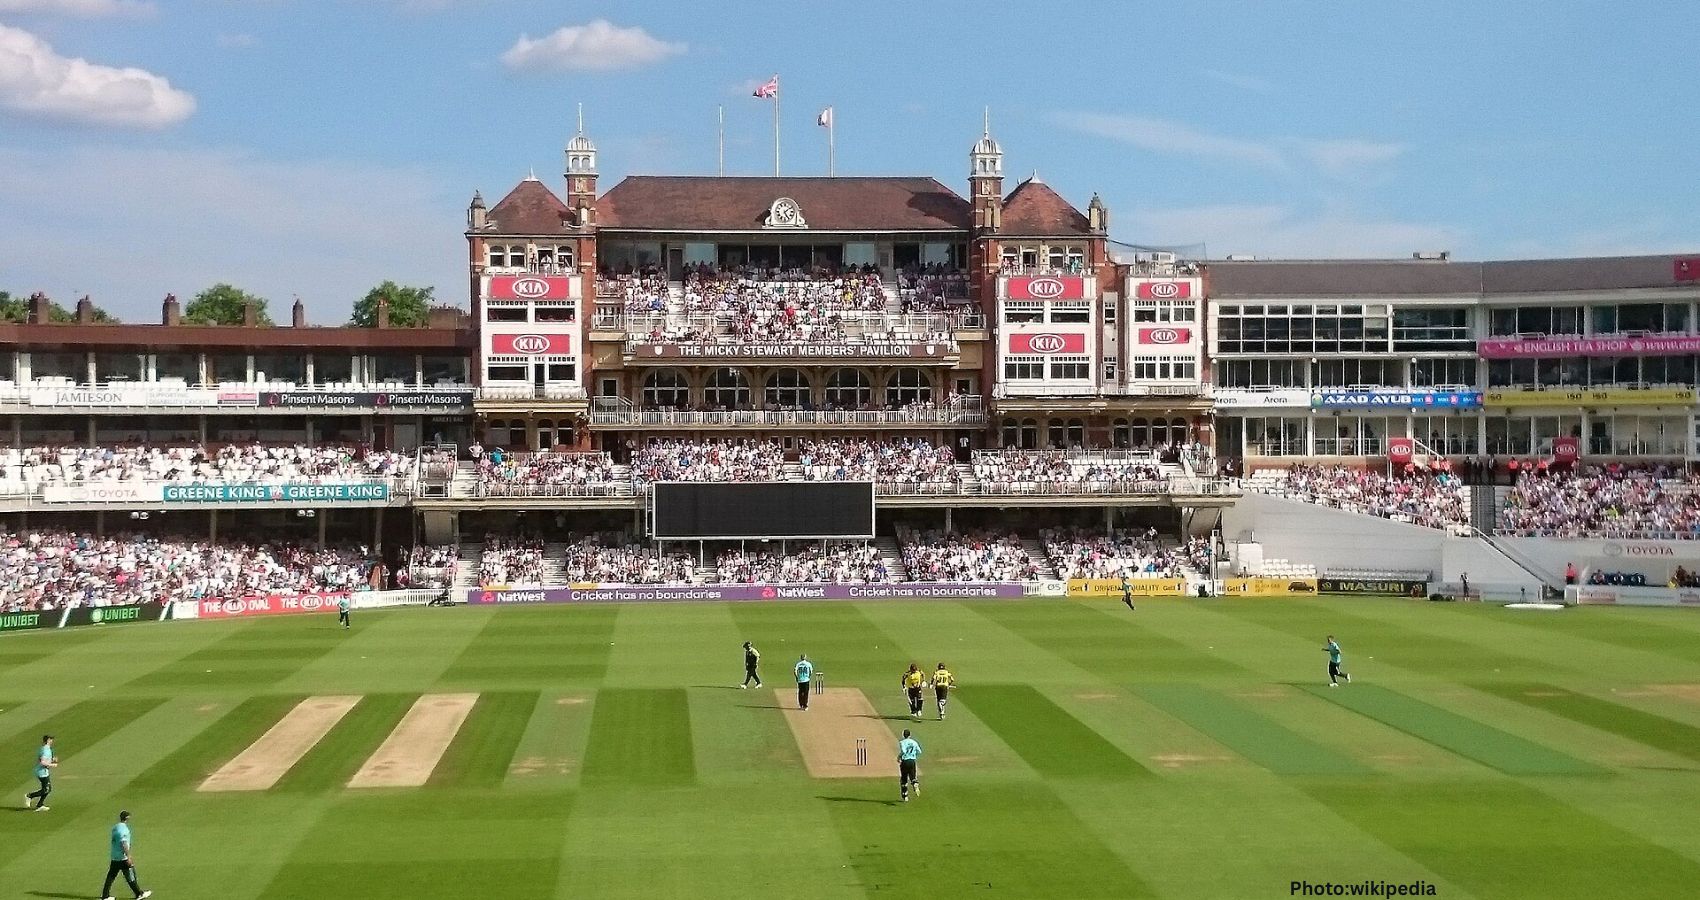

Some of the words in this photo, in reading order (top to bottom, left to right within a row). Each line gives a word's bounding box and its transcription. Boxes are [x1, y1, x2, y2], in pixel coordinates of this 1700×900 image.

[519, 282, 544, 294] KIA
[1034, 283, 1059, 294] KIA
[1155, 285, 1175, 295] KIA
[1155, 331, 1174, 341] KIA
[519, 338, 544, 350] KIA
[1035, 338, 1060, 349] KIA
[1524, 342, 1570, 353] ENGLISH
[1573, 341, 1593, 352] TEA
[1596, 341, 1627, 351] SHOP
[679, 345, 701, 356] THE
[704, 345, 741, 356] MICKY
[743, 345, 795, 356] STEWART
[799, 345, 856, 356] MEMBERS'
[860, 345, 911, 356] PAVILION
[55, 392, 122, 404] JAMIESON
[281, 394, 316, 404] Pinsent
[317, 394, 355, 404] Masons
[389, 394, 423, 404] Pinsent
[424, 394, 462, 404] Masons
[1215, 396, 1238, 404] Arora
[1263, 396, 1288, 404] Arora
[1324, 395, 1368, 404] AZAD
[1370, 395, 1411, 404] AYUB
[91, 489, 138, 498] TOYOTA
[168, 487, 224, 499] GREENE
[229, 487, 264, 498] KING
[289, 486, 343, 497] GREENE
[347, 486, 383, 497] KING
[1626, 546, 1674, 556] TOYOTA
[777, 587, 824, 598] NatWest
[849, 586, 891, 596] Cricket
[893, 586, 913, 596] has
[916, 588, 930, 596] no
[932, 586, 997, 596] boundaries
[1339, 582, 1404, 592] MASURI
[497, 591, 545, 601] NatWest
[571, 590, 613, 600] Cricket
[616, 590, 636, 600] has
[639, 592, 654, 600] no
[656, 590, 721, 600] boundaries
[203, 602, 222, 613] THE
[249, 599, 270, 610] OVAL
[281, 598, 298, 609] THE
[105, 607, 140, 620] UNIBET
[4, 614, 40, 627] UNIBET
